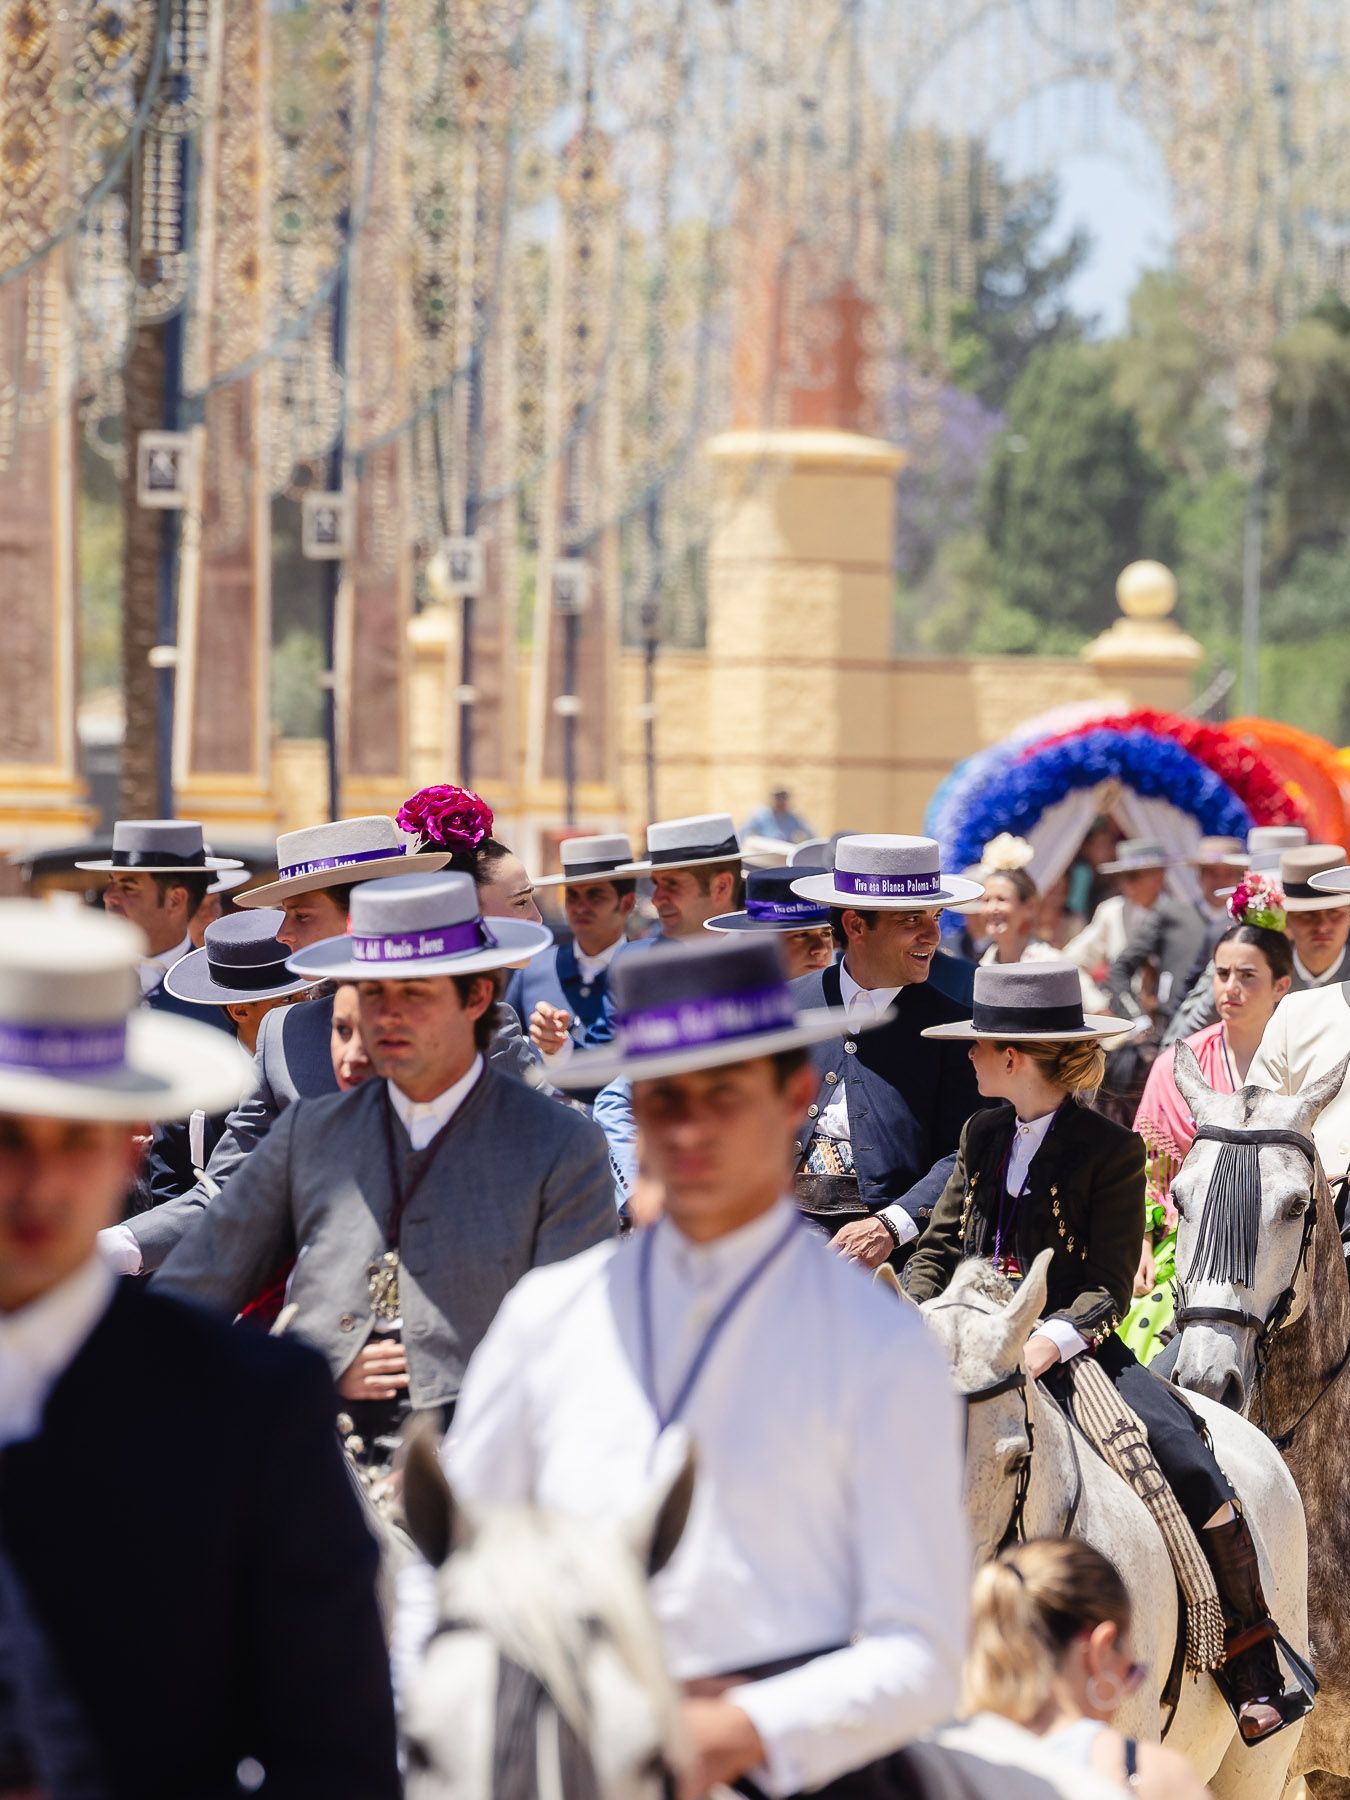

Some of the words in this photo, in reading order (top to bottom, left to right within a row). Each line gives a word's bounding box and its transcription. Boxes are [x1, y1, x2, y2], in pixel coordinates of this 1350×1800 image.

[854, 878, 868, 892] Viva
[869, 882, 880, 892] esa
[882, 879, 905, 893] Blanca
[907, 878, 929, 893] Paloma
[773, 904, 786, 914] Viva
[786, 905, 796, 914] esa
[796, 903, 816, 912] Blanca
[418, 935, 444, 956] Jerez
